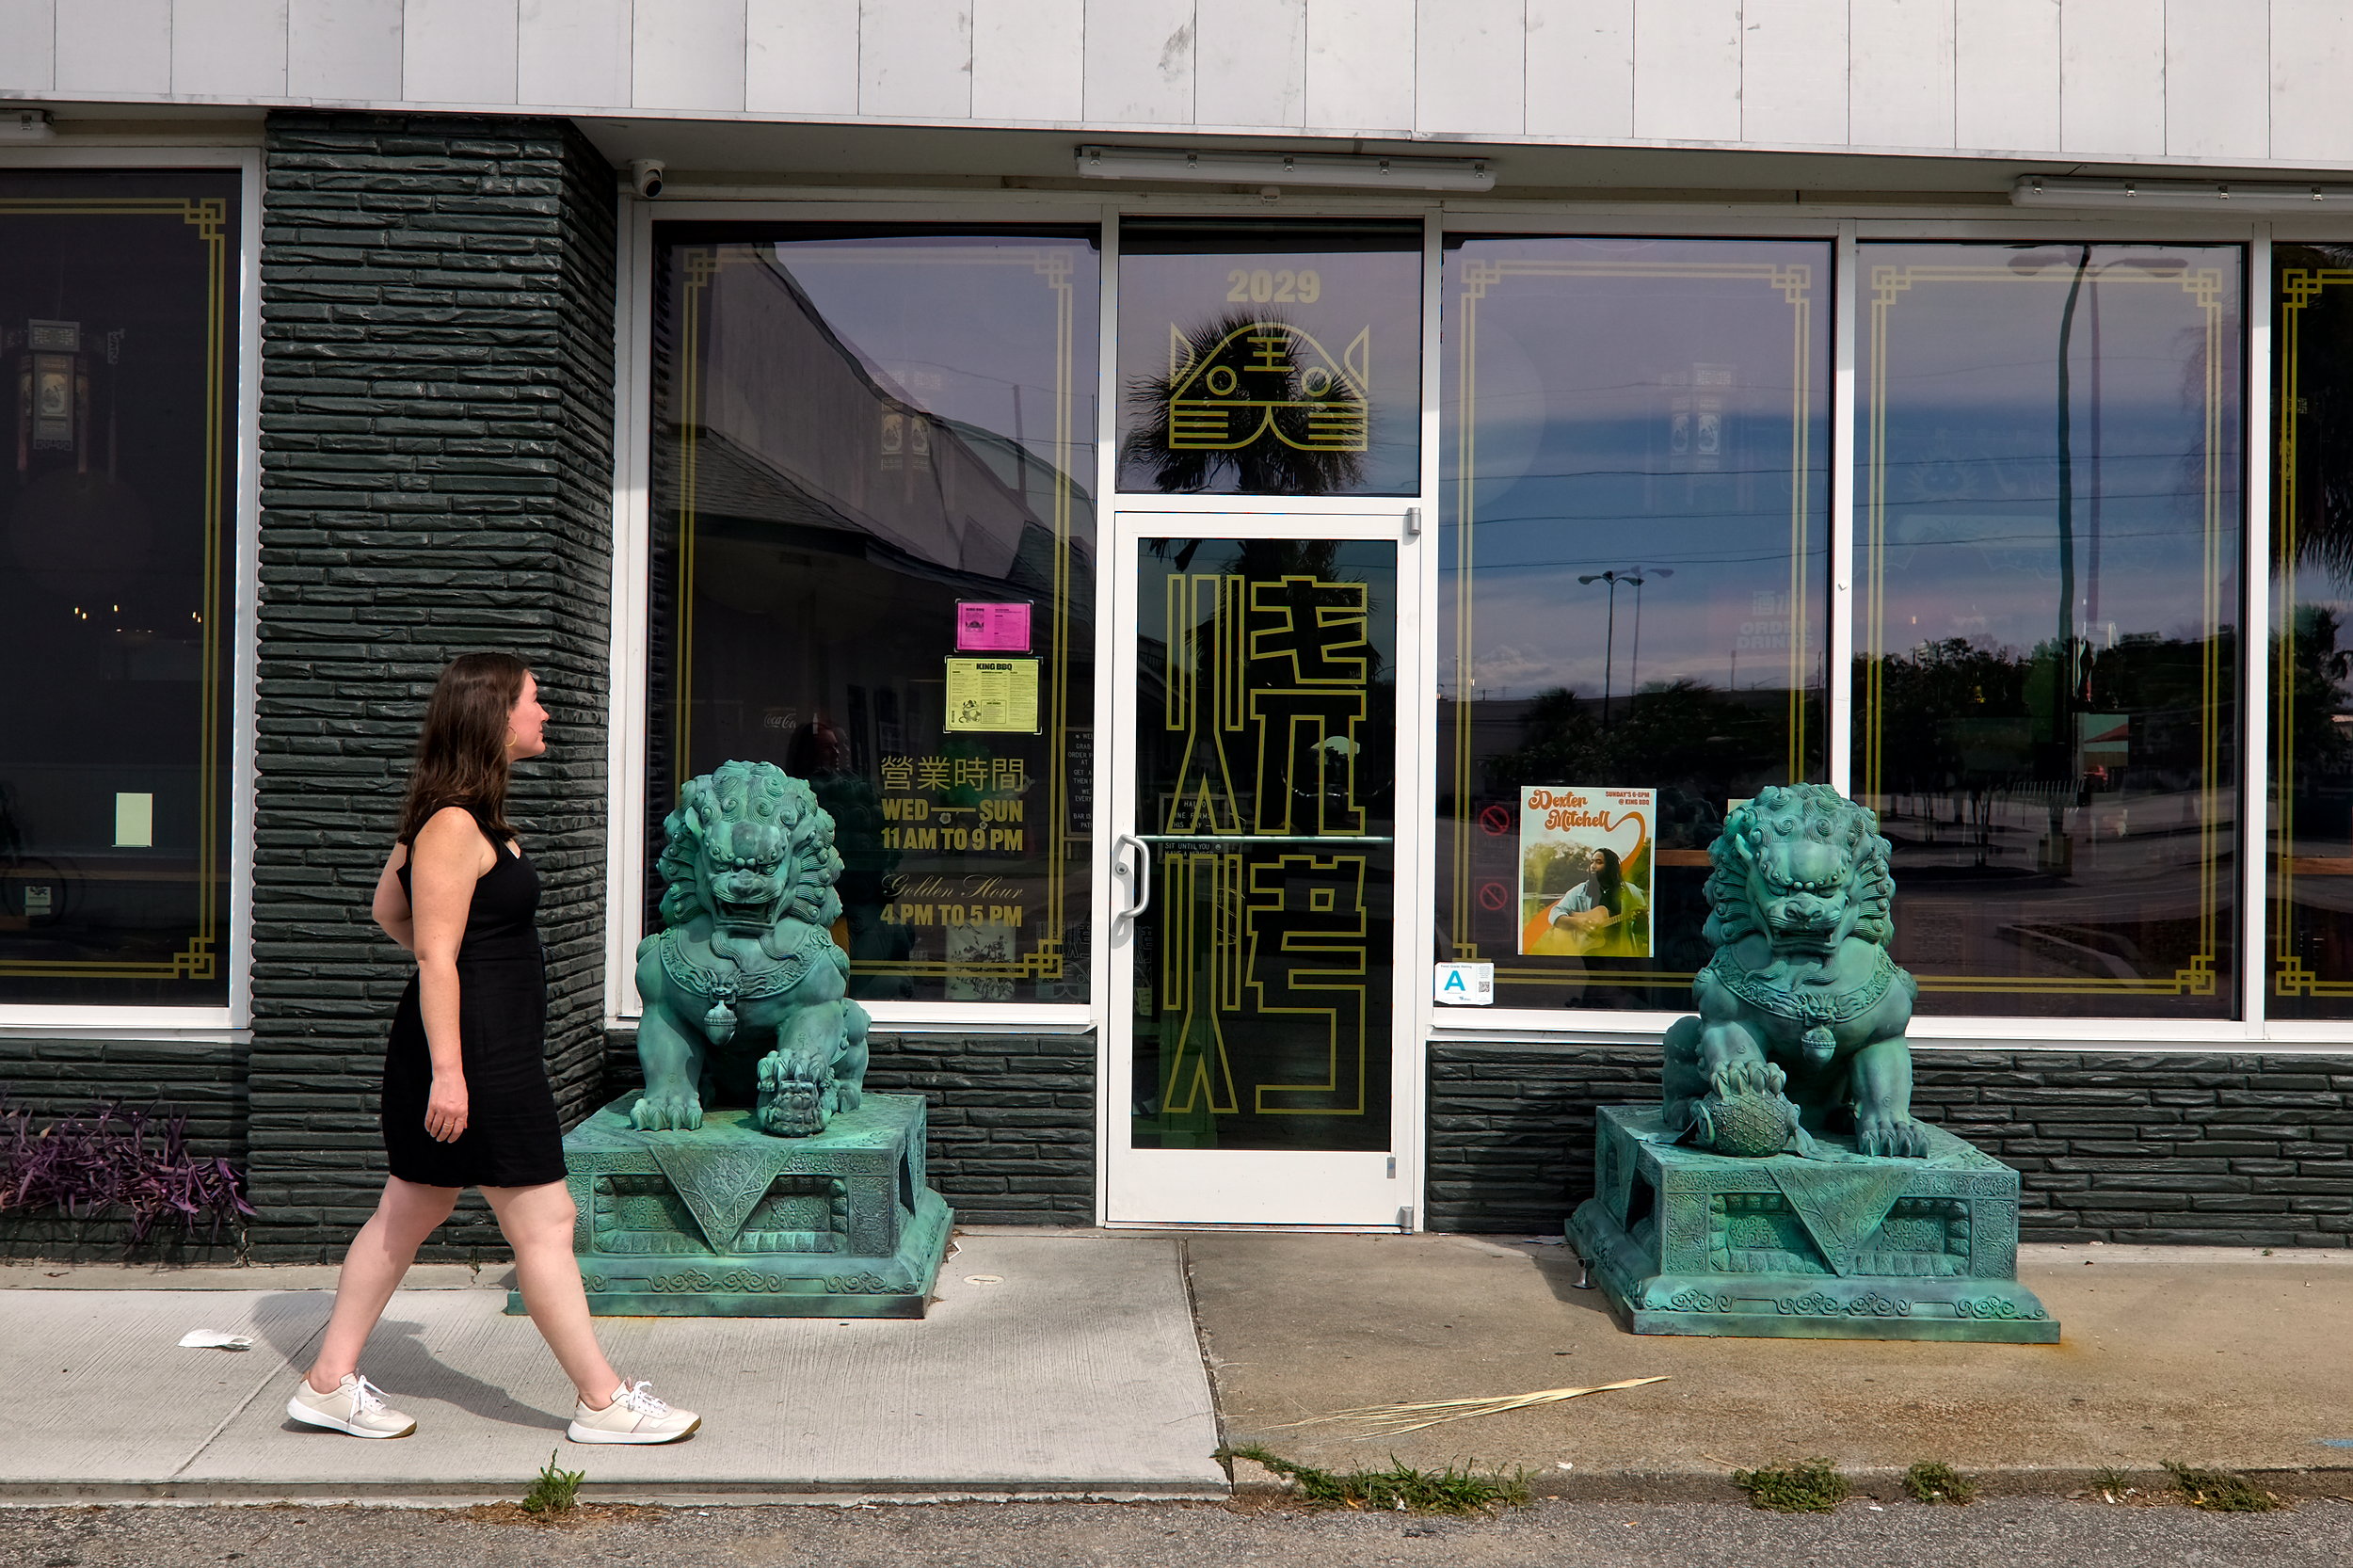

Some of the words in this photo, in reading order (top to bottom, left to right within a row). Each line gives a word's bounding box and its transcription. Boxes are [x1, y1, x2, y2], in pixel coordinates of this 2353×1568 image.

[1226, 269, 1321, 304] 2029
[996, 663, 1013, 671] BBQ
[881, 755, 1025, 792] 營業時間
[881, 798, 929, 822] WED
[979, 799, 1024, 823] SUN
[1528, 789, 1589, 810] Dexter
[1545, 809, 1612, 833] Mitchell
[881, 827, 900, 849] 11
[903, 827, 937, 850] AM
[940, 828, 968, 850] TO
[971, 828, 986, 851] 9
[989, 829, 1024, 851] PM
[881, 873, 954, 899] Golden
[960, 873, 1024, 900] Hour
[879, 904, 894, 926] 4
[900, 904, 934, 926] PM
[937, 904, 966, 926] TO
[969, 904, 984, 927] 5
[989, 905, 1023, 927] PM
[1444, 969, 1466, 991] A
